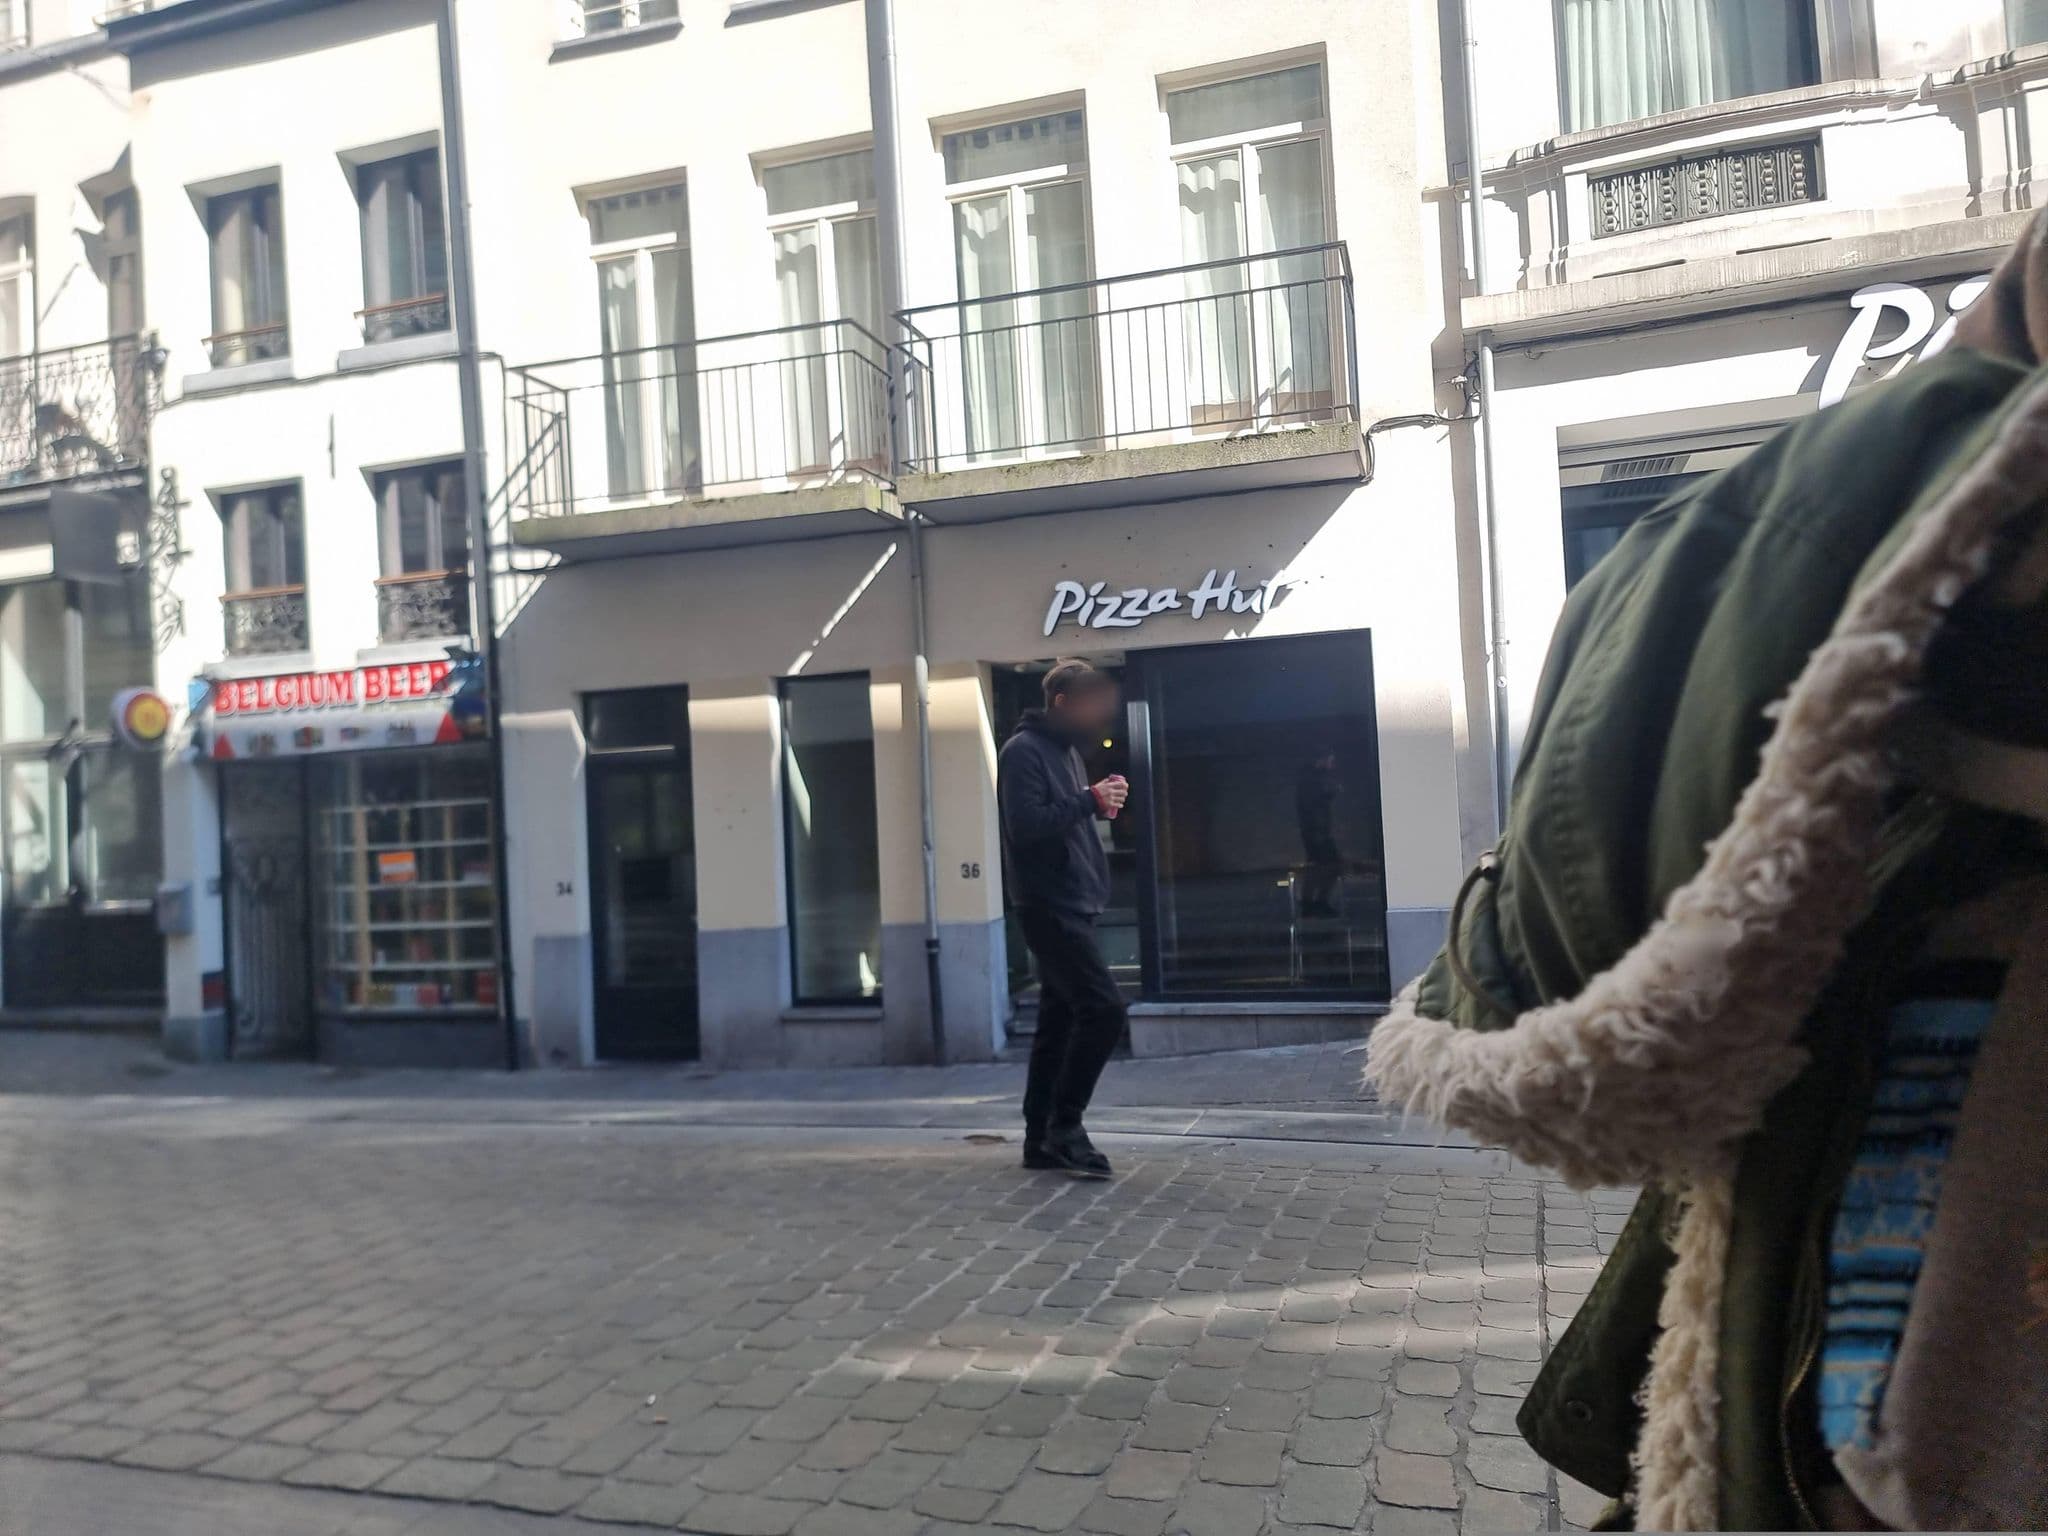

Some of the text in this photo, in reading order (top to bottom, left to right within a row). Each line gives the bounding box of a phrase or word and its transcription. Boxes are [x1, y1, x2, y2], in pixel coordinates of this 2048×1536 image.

[1043, 568, 1288, 637] Pizza Hut
[215, 671, 356, 714] BELGIUM
[961, 862, 981, 879] 36
